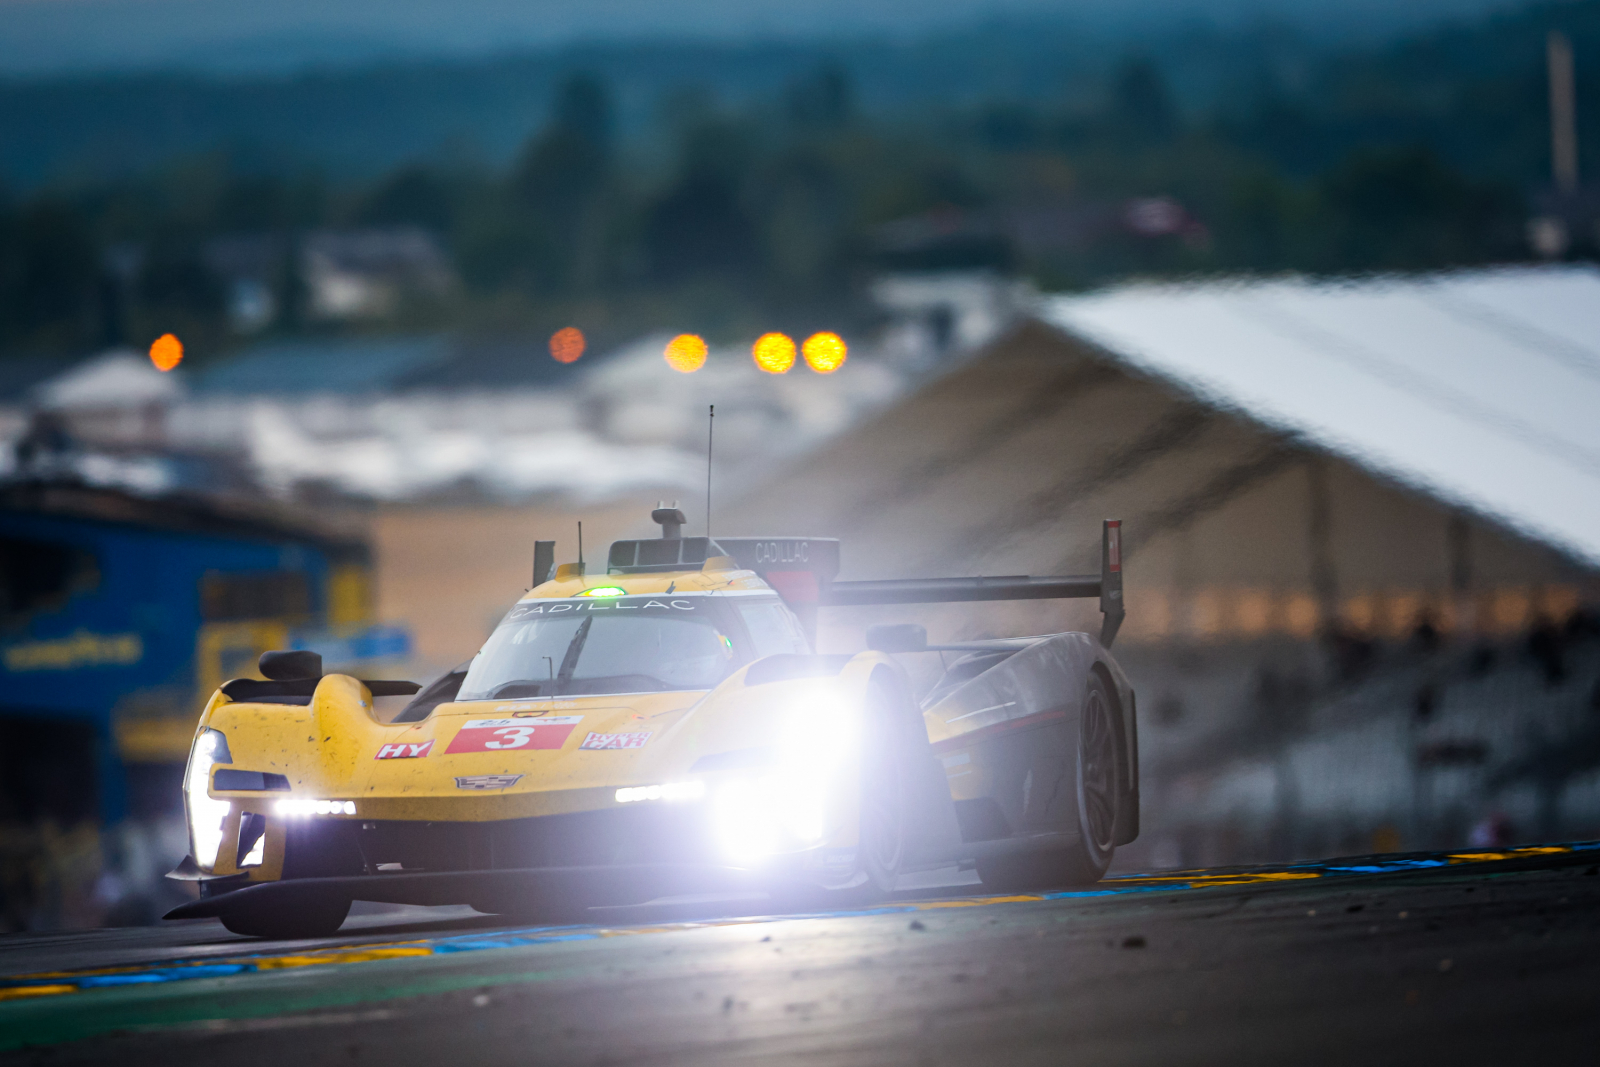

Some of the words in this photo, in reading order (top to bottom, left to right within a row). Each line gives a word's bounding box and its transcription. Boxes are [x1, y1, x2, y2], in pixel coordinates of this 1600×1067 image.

[756, 542, 808, 563] CADILLAC
[510, 599, 695, 619] CADILLAC
[485, 727, 535, 749] 3
[584, 738, 645, 748] CAR
[377, 741, 432, 758] HY
